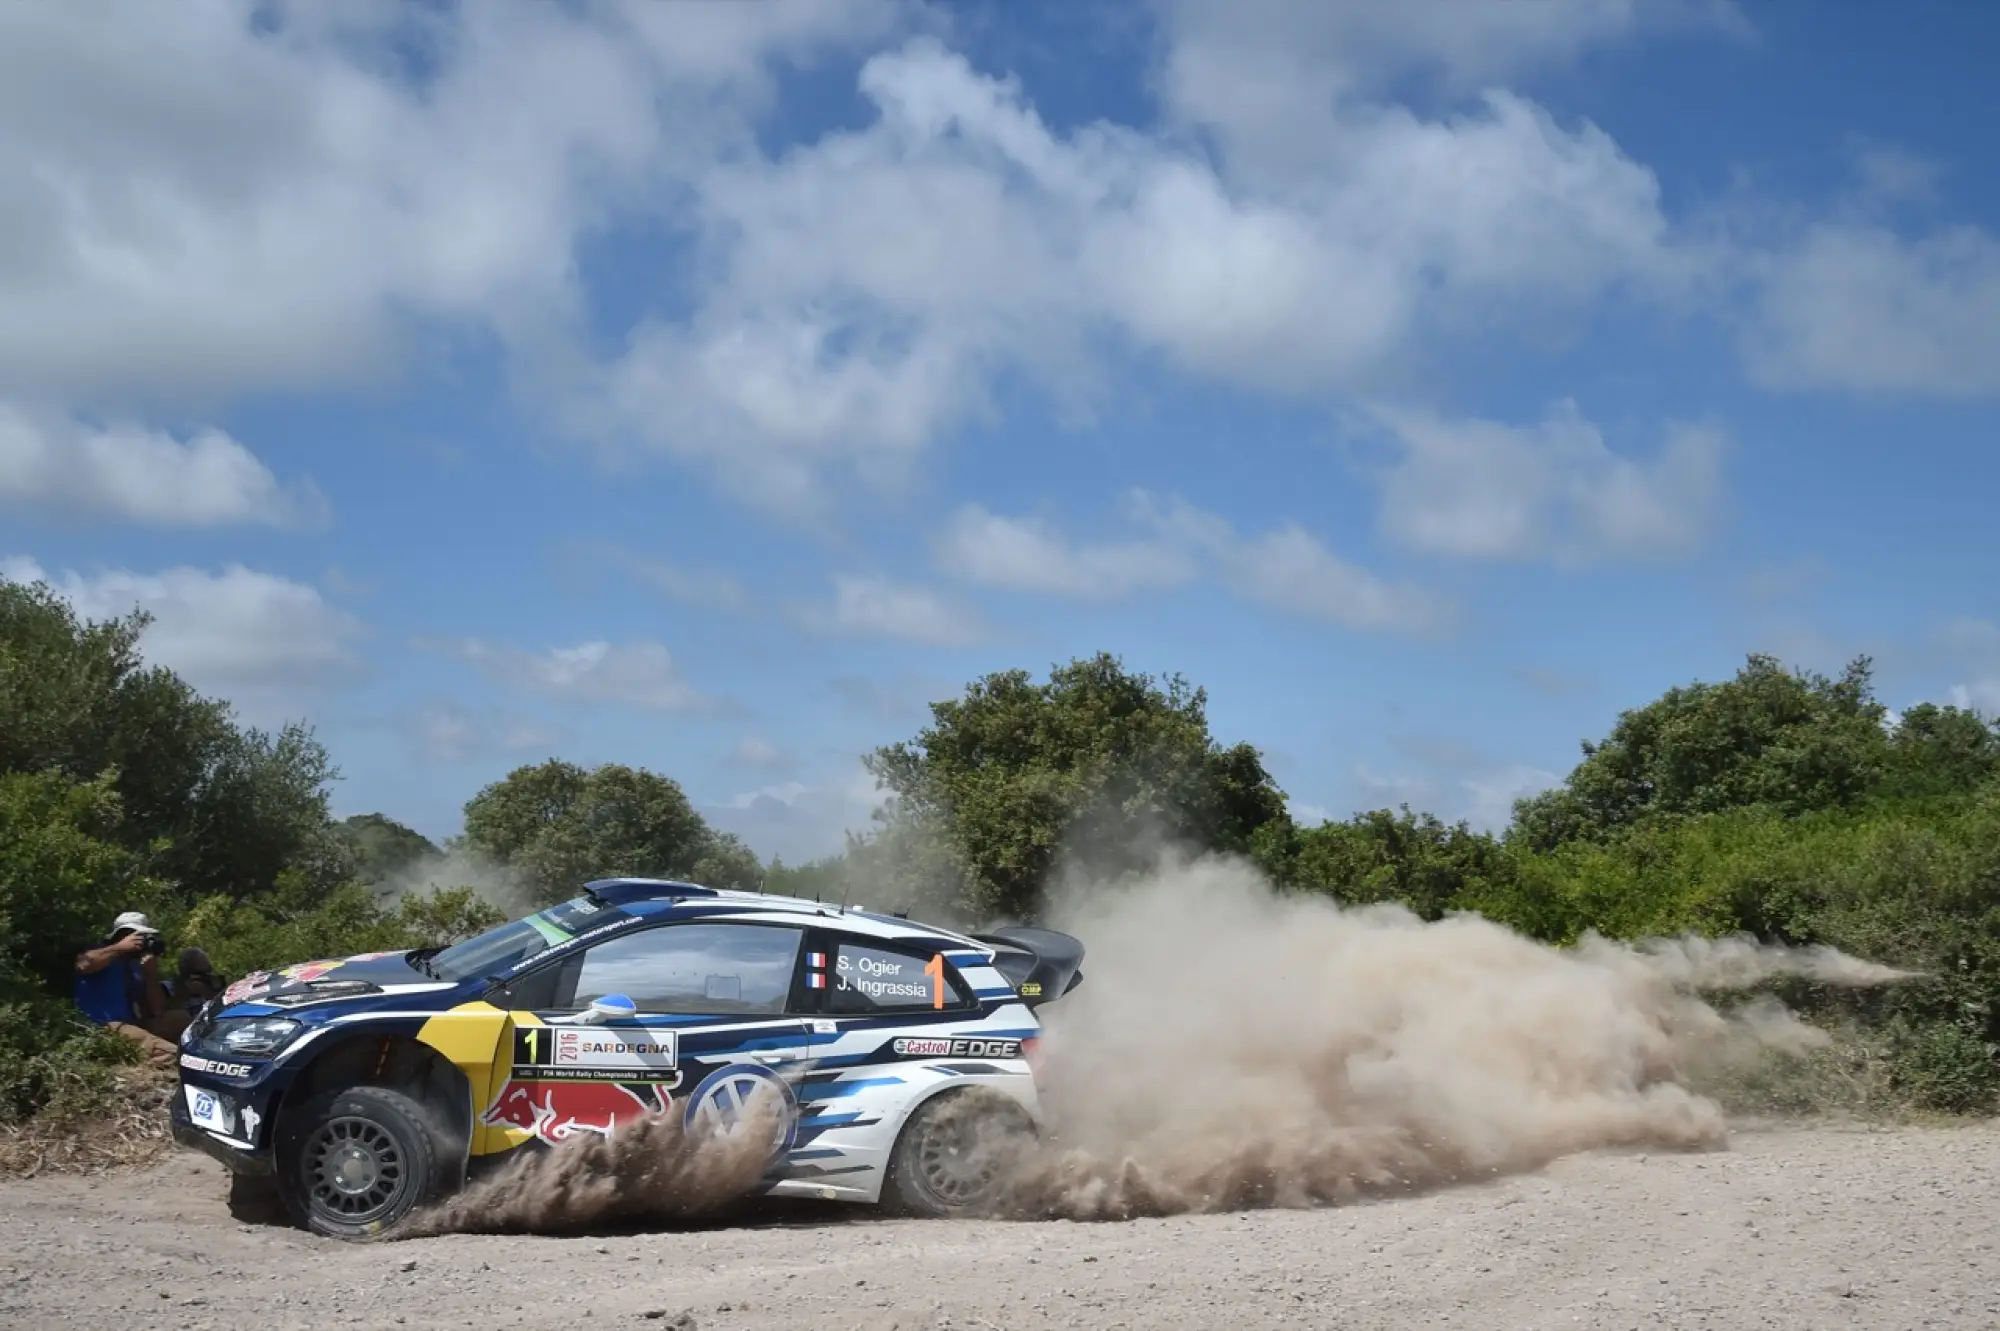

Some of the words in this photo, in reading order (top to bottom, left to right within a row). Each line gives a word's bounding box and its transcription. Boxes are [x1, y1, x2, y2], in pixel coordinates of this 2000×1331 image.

[837, 955, 853, 971] S.
[859, 957, 903, 977] Ogier
[837, 976, 852, 991] J.
[857, 977, 927, 998] Ingrassia
[924, 953, 944, 1010] 1
[524, 1029, 538, 1064] 1
[559, 1033, 579, 1061] 2016
[582, 1042, 670, 1054] SARDEGNA
[907, 1040, 948, 1054] Castrol
[950, 1040, 1019, 1057] EDGE
[205, 1060, 253, 1078] EDGE
[555, 1069, 575, 1077] World
[576, 1069, 593, 1079] Rally
[593, 1071, 638, 1080] Championship
